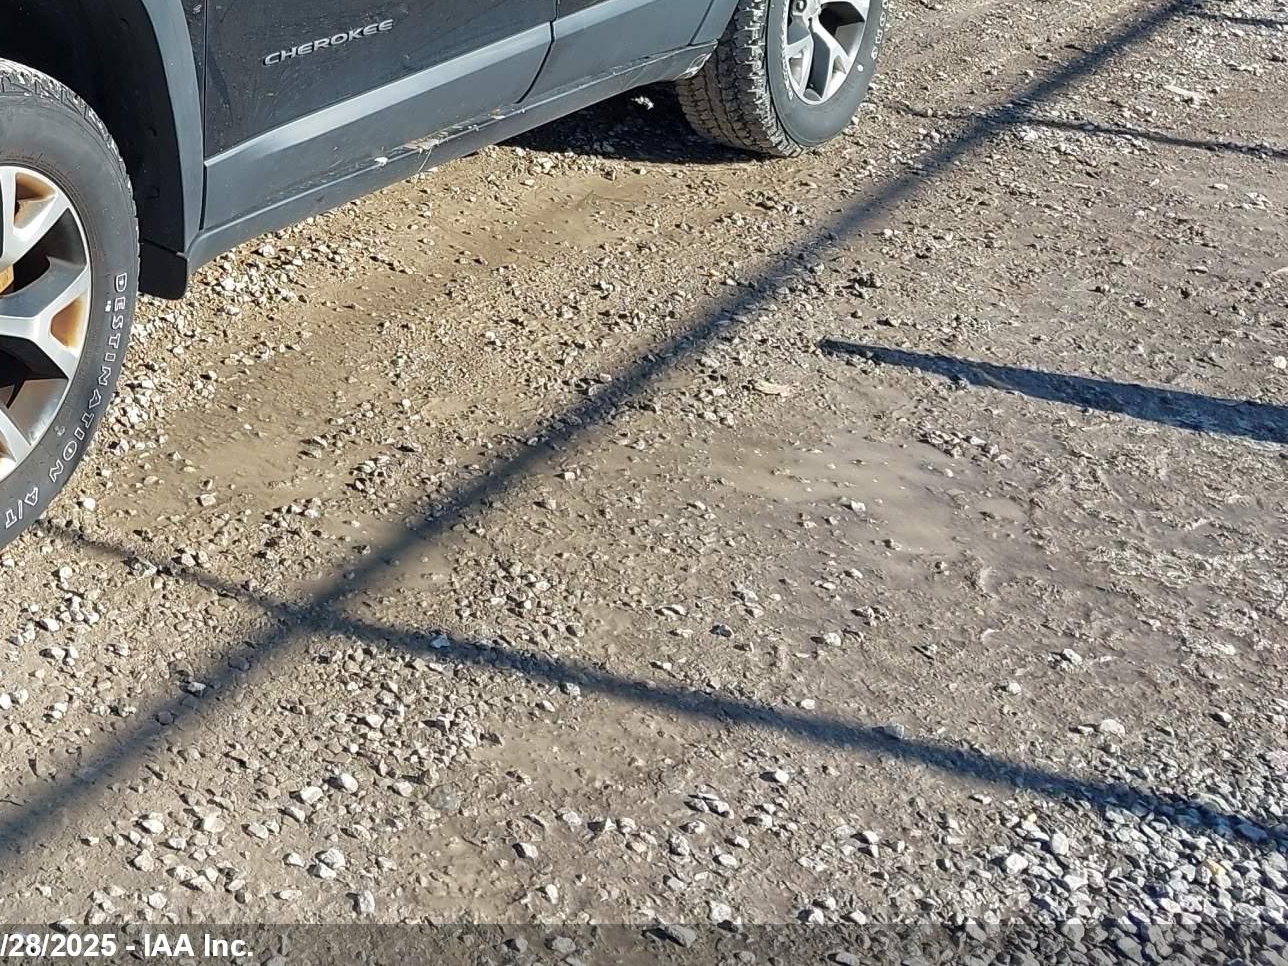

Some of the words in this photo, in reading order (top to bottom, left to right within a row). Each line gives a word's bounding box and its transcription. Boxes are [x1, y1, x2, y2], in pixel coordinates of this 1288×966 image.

[263, 19, 394, 66] CHEROKEE
[49, 273, 127, 483] DESTINATION
[5, 487, 39, 529] A/T
